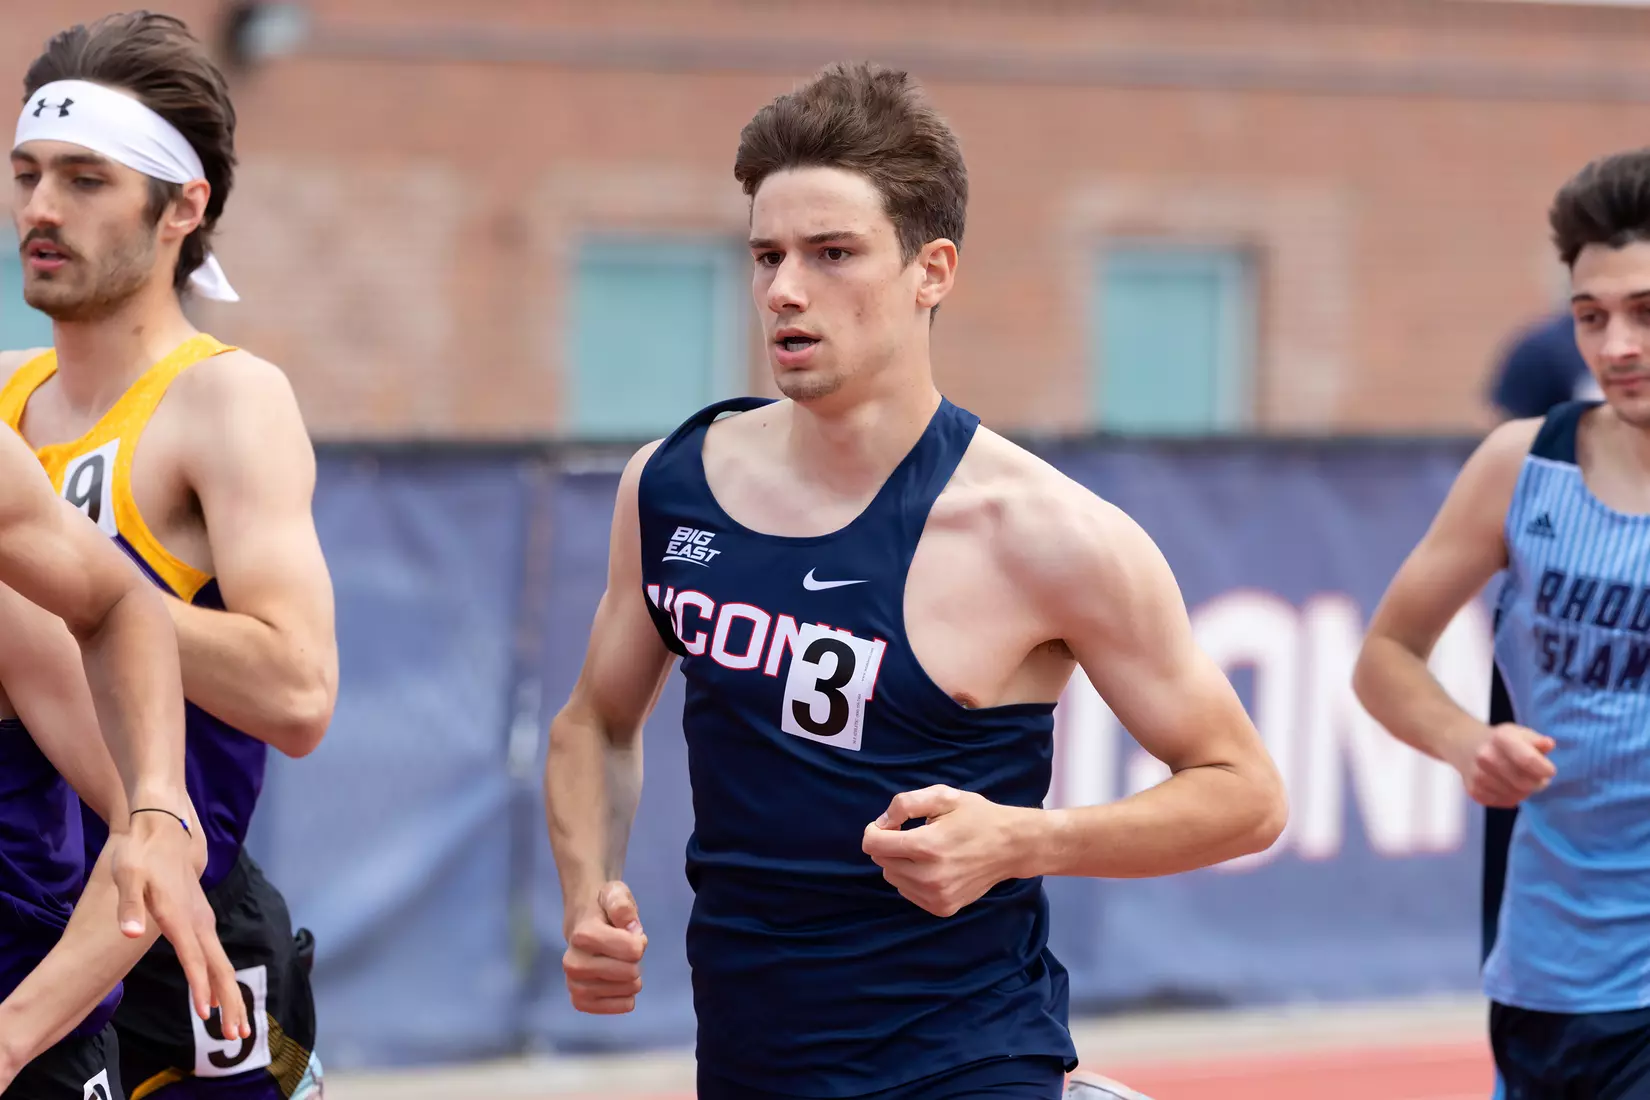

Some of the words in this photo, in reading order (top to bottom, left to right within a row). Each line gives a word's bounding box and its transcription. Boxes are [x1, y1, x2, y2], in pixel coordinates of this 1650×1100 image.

[65, 454, 105, 524] 9
[665, 540, 722, 562] EAST
[670, 526, 716, 546] BIG
[791, 637, 856, 737] 3
